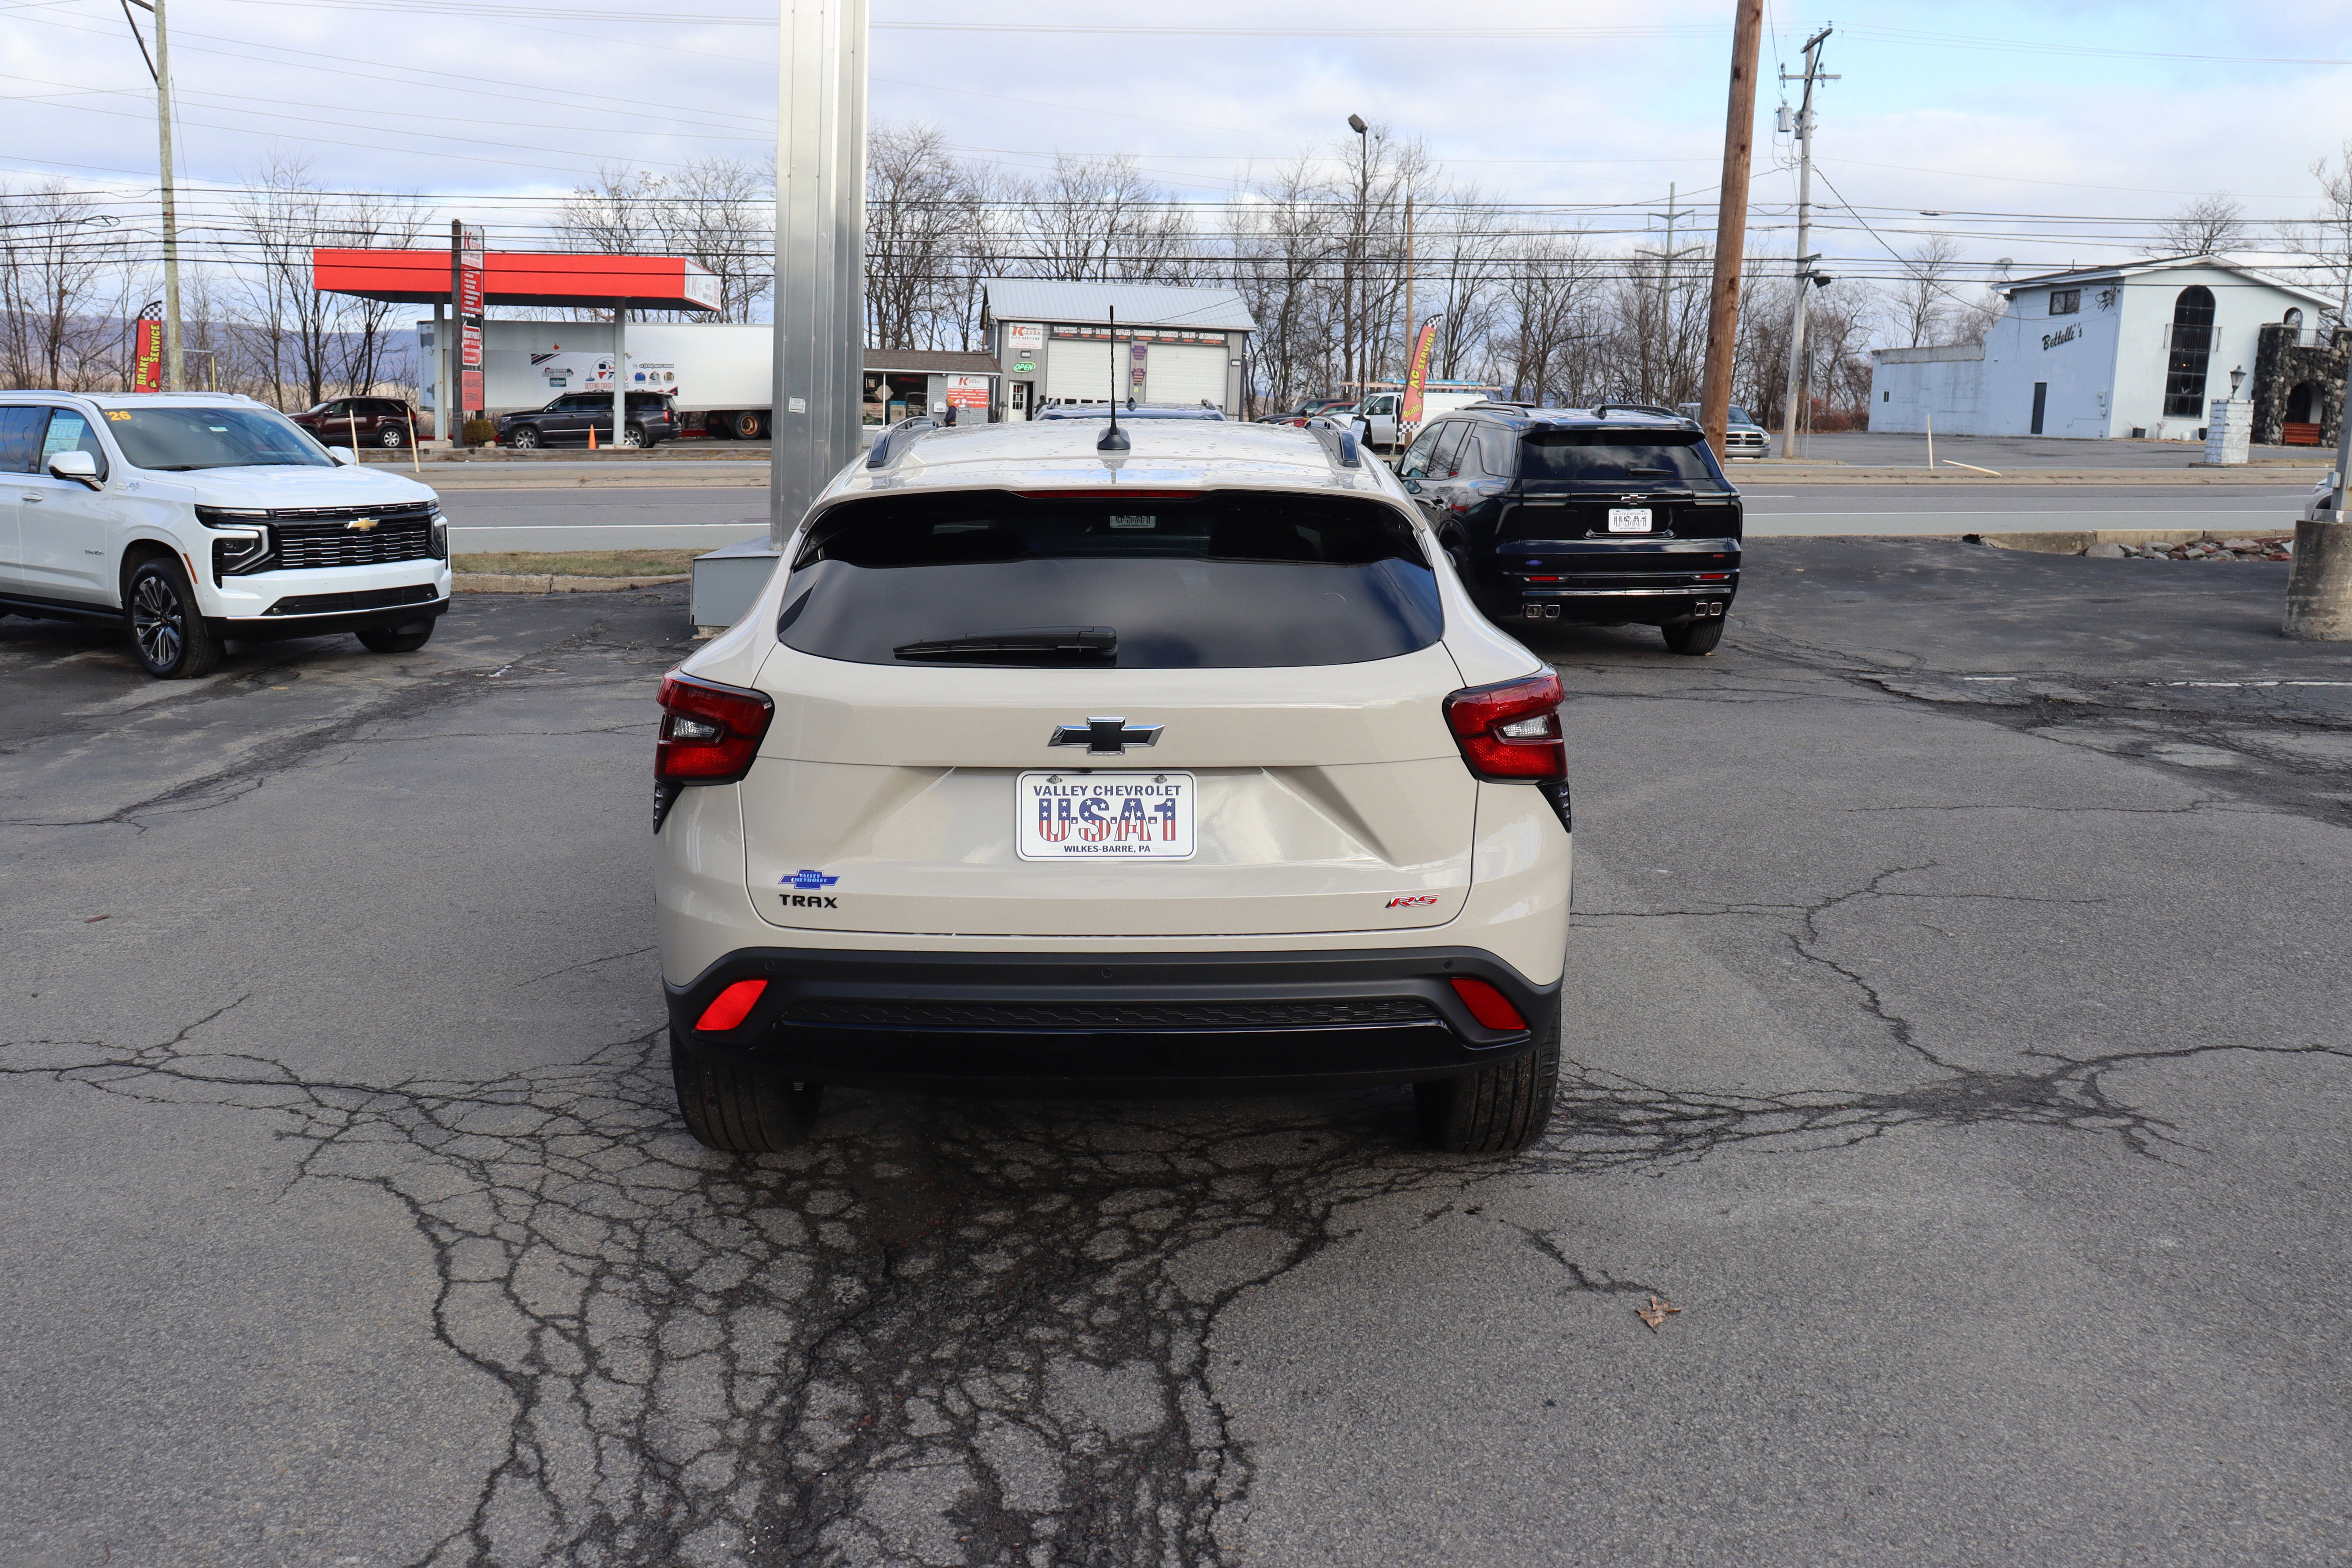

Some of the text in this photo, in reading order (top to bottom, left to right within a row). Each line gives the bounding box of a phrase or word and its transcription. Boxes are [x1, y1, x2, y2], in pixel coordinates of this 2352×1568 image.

[149, 324, 160, 363] SERVICE
[1418, 331, 1436, 370] SERVICE
[136, 355, 150, 385] BRAKE
[1403, 403, 1422, 418] Quality
[1033, 785, 1181, 796] VALLEY CHEVROLET
[1063, 845, 1136, 853] WILKES-BARRE,
[779, 894, 838, 908] TRAX
[1387, 893, 1440, 908] RS
